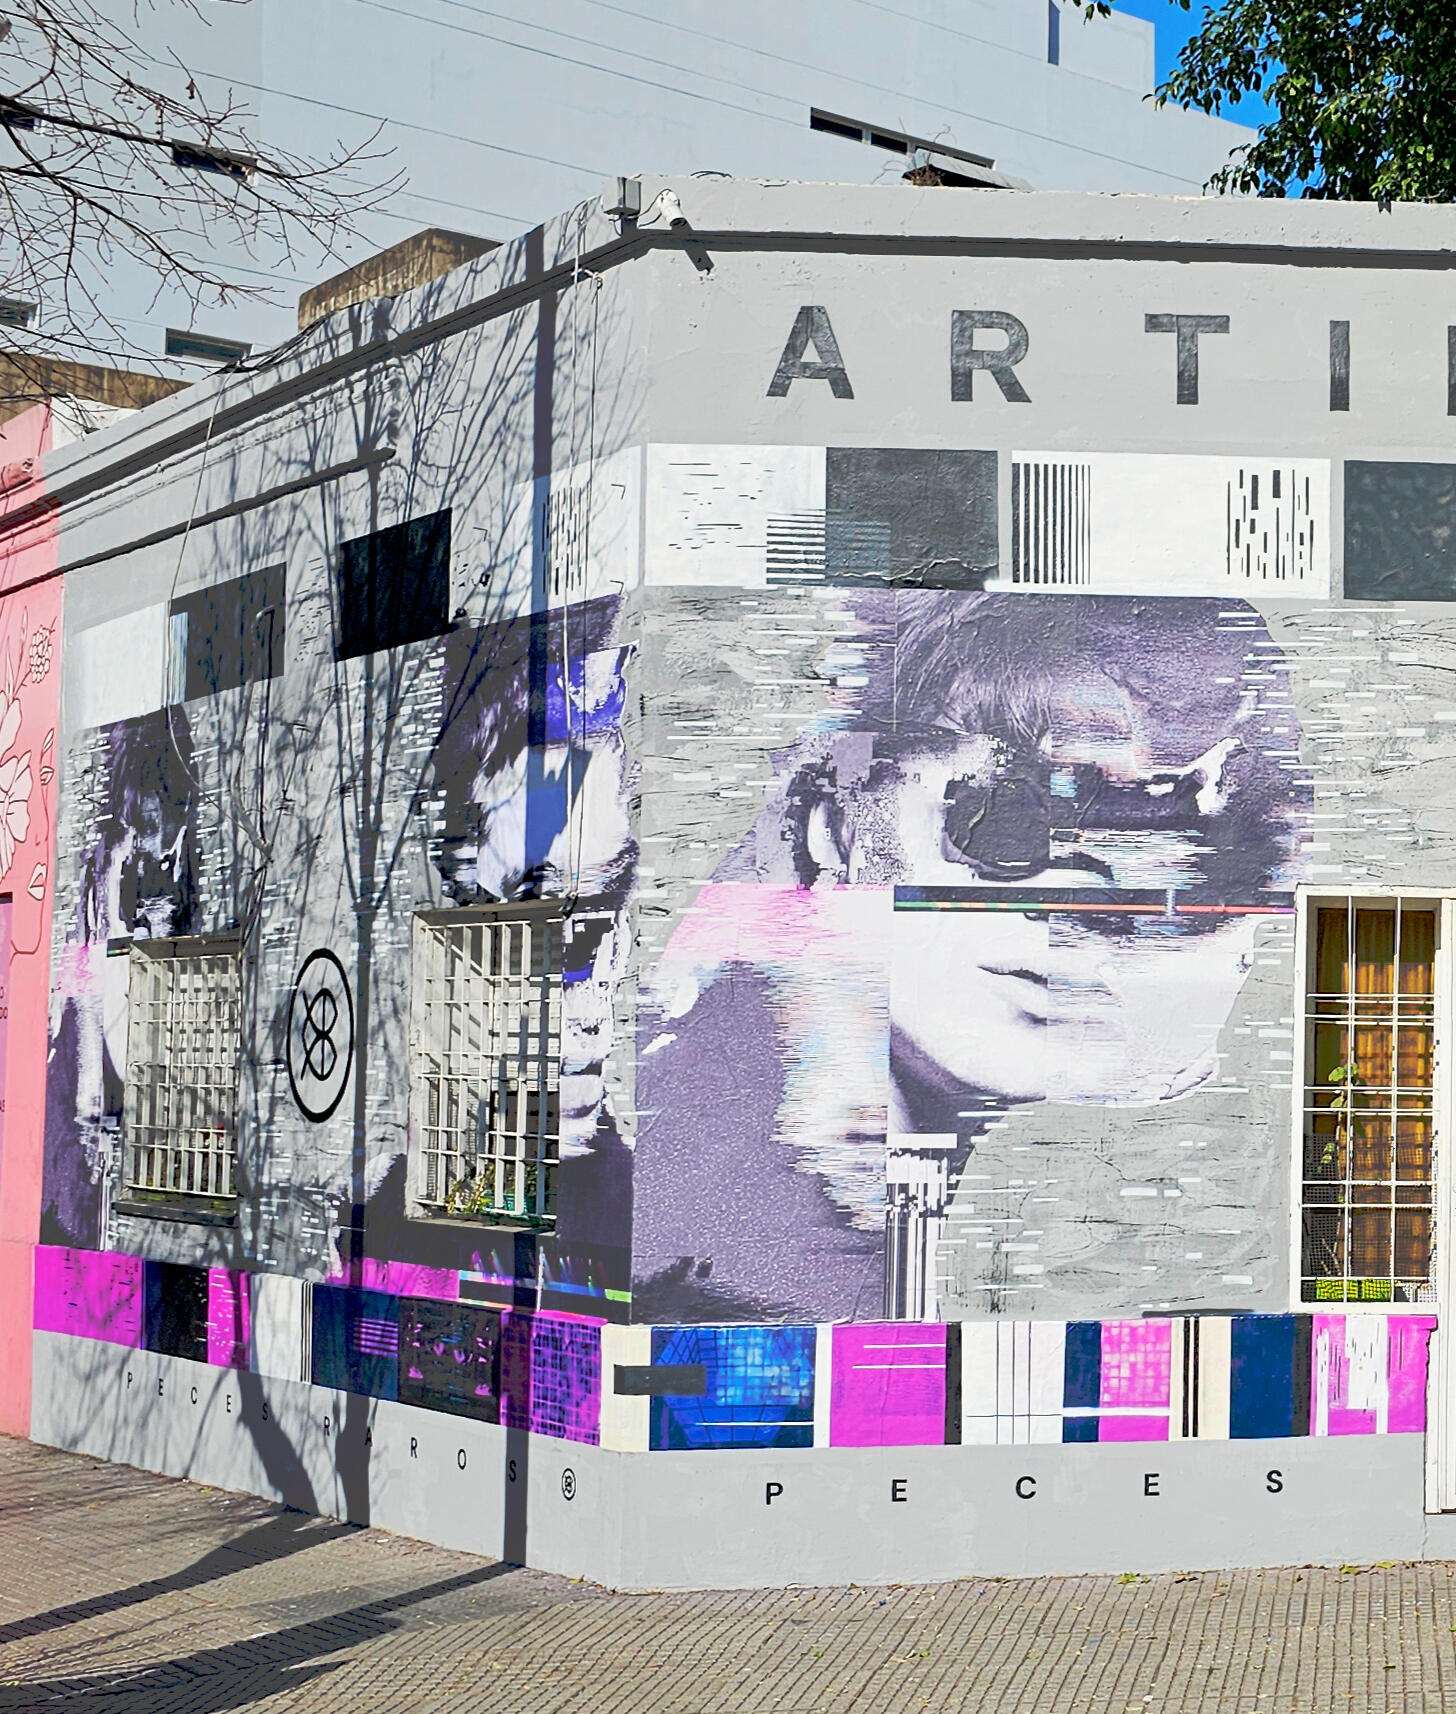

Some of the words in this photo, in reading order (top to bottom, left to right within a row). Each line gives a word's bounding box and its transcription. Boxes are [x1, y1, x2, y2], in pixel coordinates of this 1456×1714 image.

[126, 1371, 271, 1422] PECES
[322, 1415, 521, 1483] RAROS
[765, 1469, 1284, 1506] PECES
